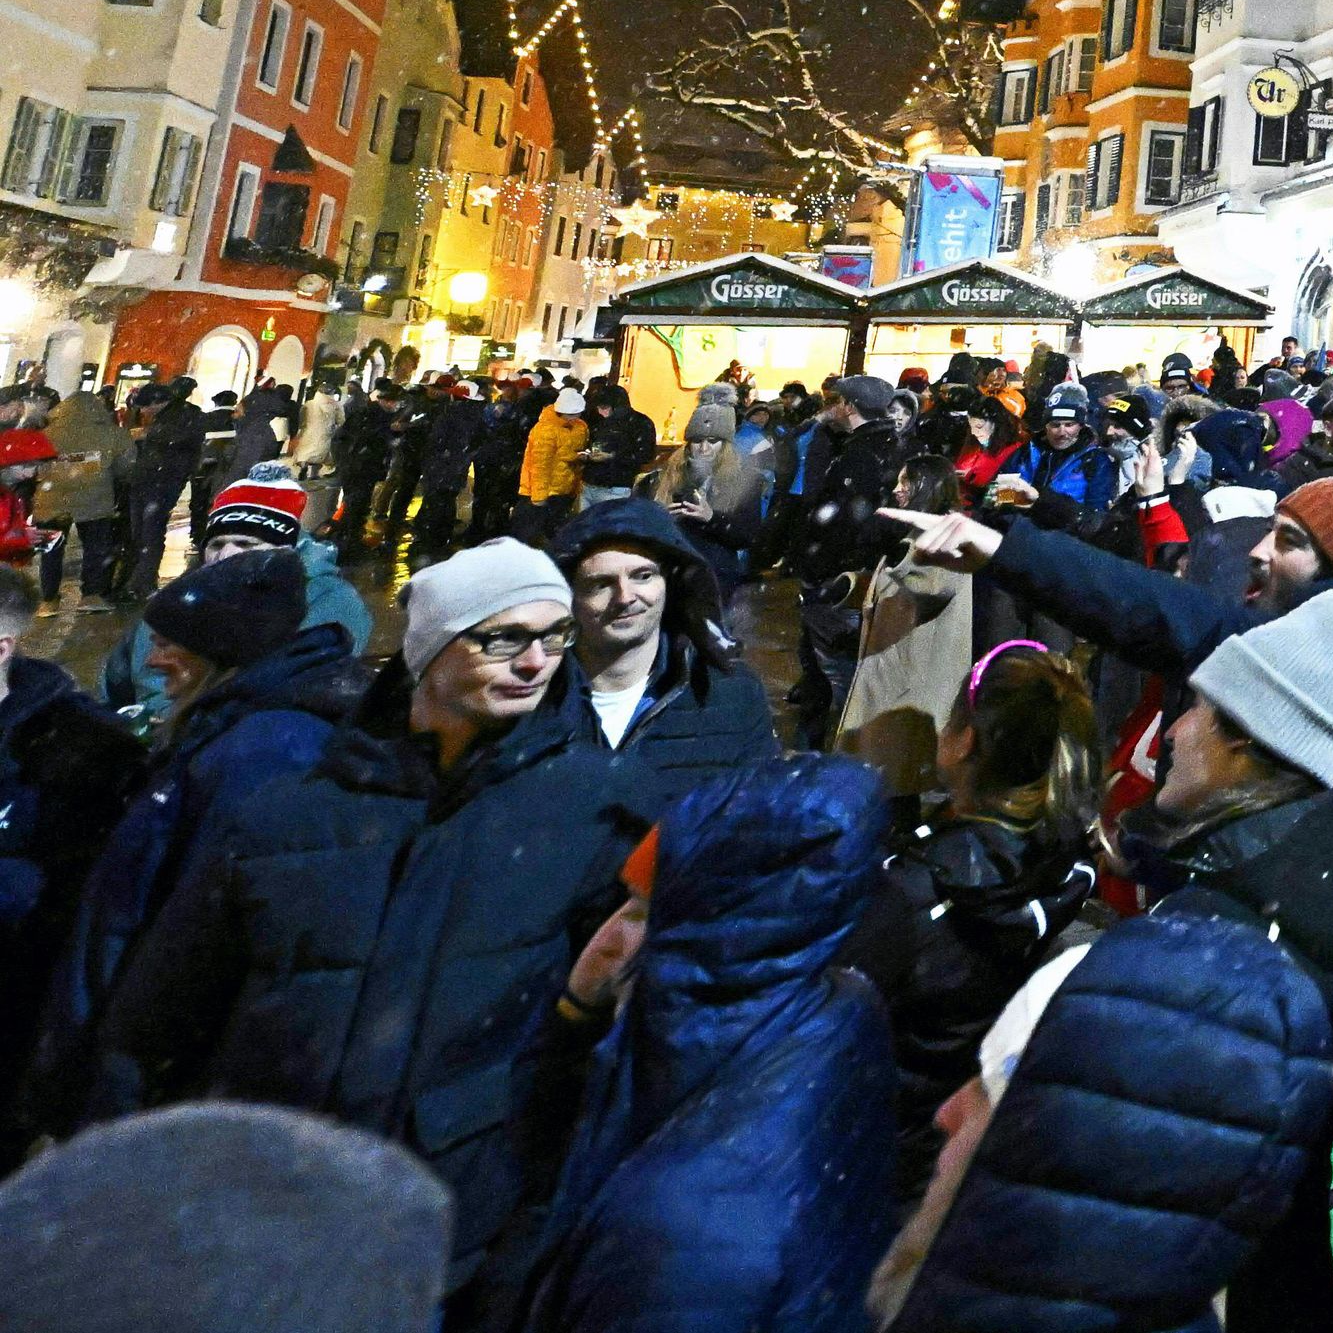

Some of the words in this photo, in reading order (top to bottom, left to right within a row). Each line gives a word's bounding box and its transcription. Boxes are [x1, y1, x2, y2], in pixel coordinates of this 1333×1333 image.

[1255, 78, 1286, 103] Ur
[711, 274, 789, 303] Gösser
[942, 279, 1014, 306] Gösser
[1146, 284, 1207, 309] Gösser
